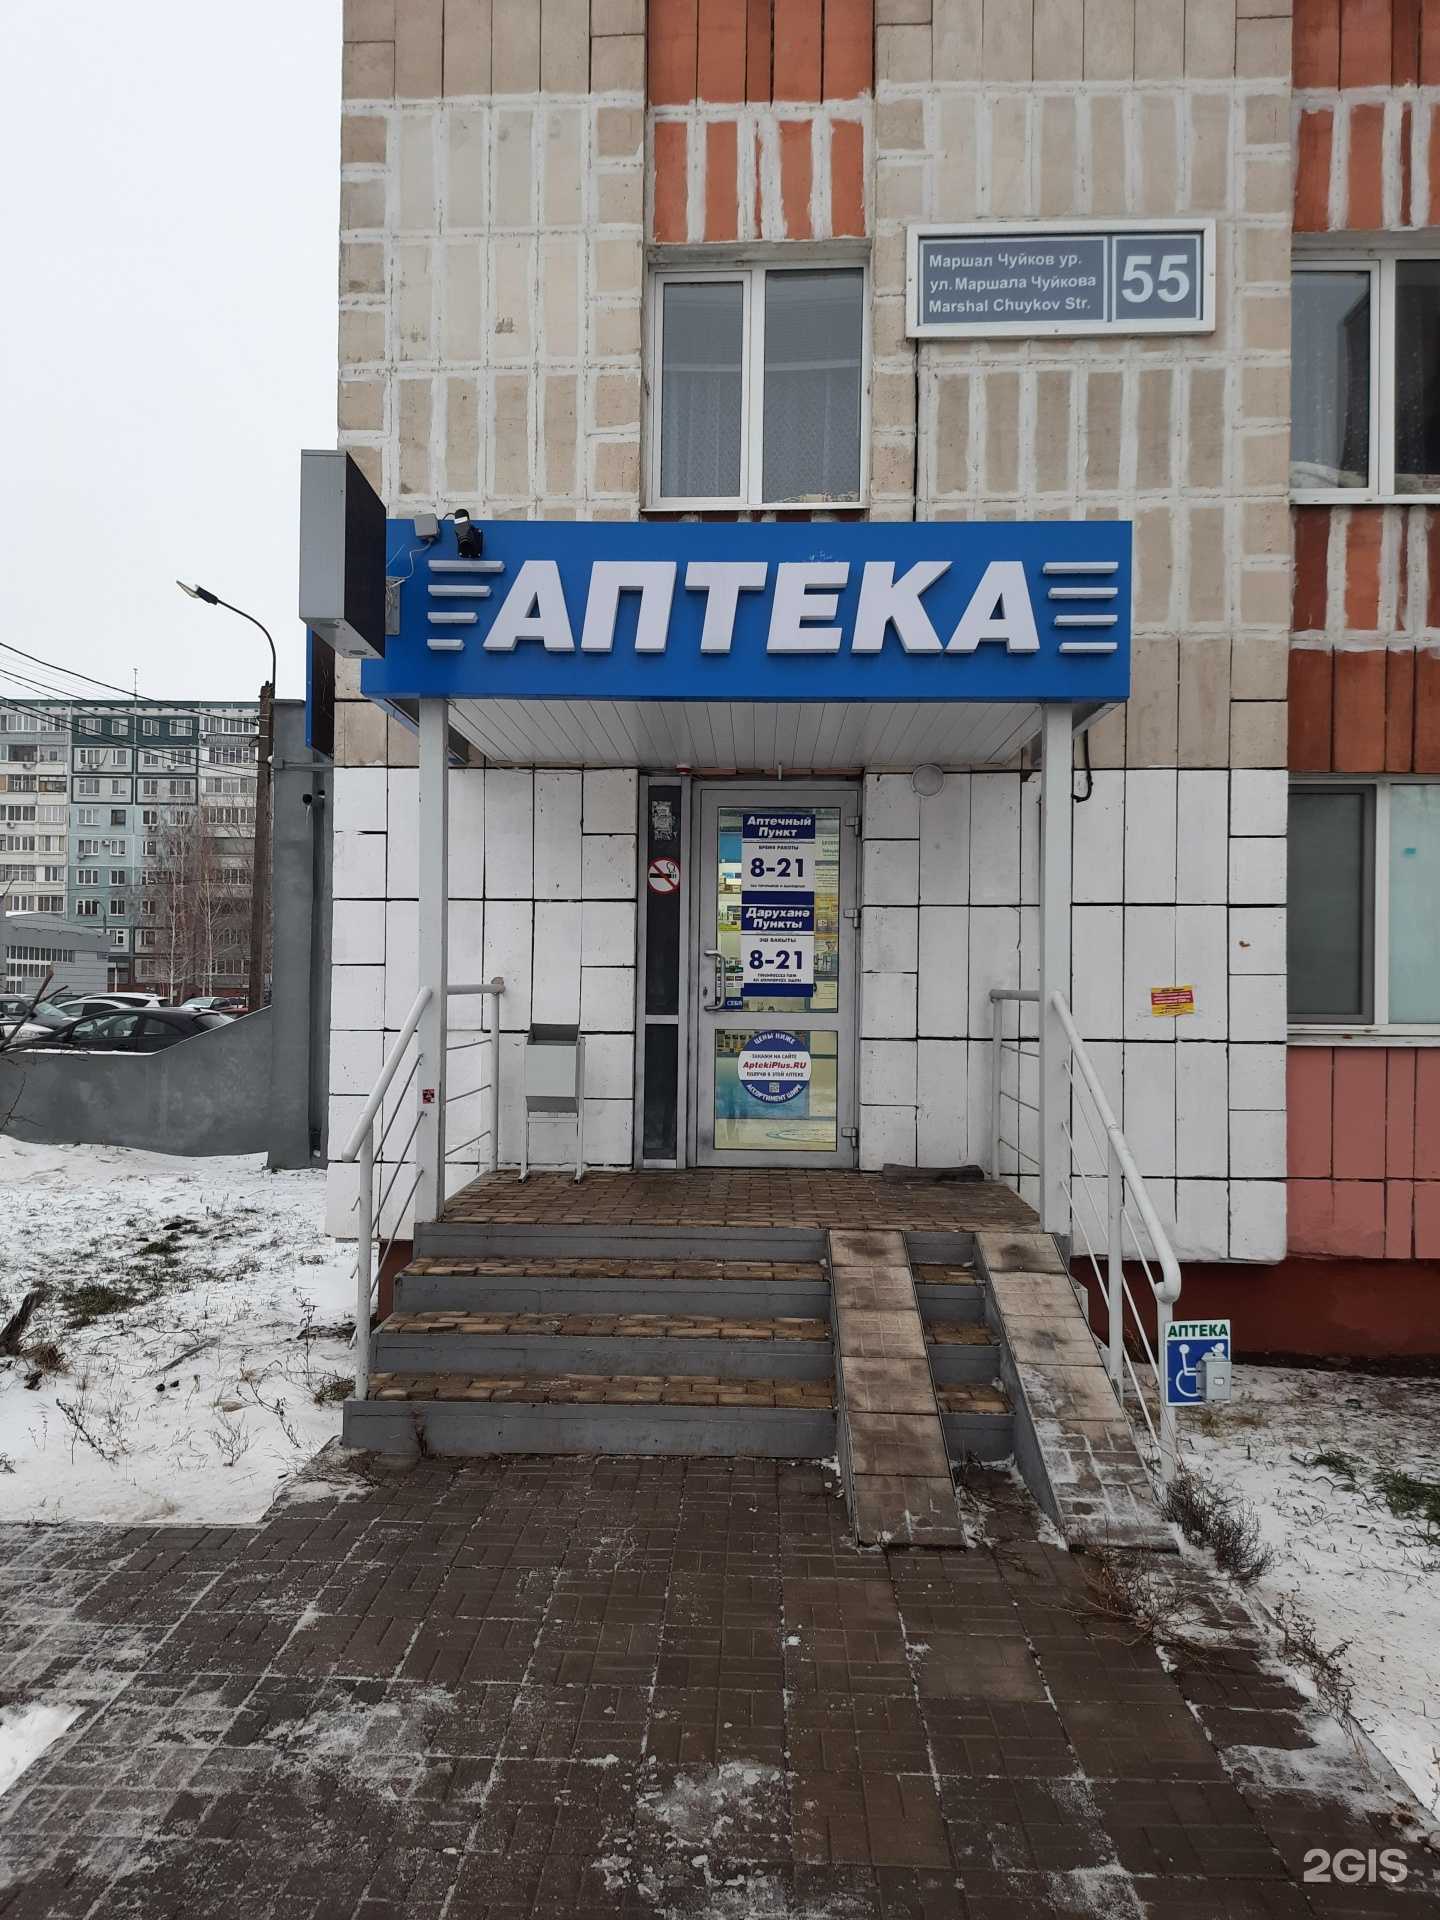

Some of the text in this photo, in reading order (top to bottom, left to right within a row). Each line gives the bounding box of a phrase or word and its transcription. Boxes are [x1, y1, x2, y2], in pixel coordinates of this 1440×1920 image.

[929, 252, 1083, 270] Маршал Чуйков ур.
[930, 275, 1096, 294] ул. Маршала Чуйкова
[1121, 254, 1190, 303] 55
[929, 297, 1091, 313] Marshal Chuykov Str.
[483, 561, 1040, 654] АПТЕКА
[747, 816, 812, 826] Аптечный
[758, 827, 798, 838] Пункт
[750, 857, 804, 877] 8-21
[753, 919, 803, 930] Пункты
[749, 950, 802, 970] 8-21
[743, 1061, 807, 1070] AptekiPlus.RU
[1168, 1324, 1229, 1338] АПТЕКА
